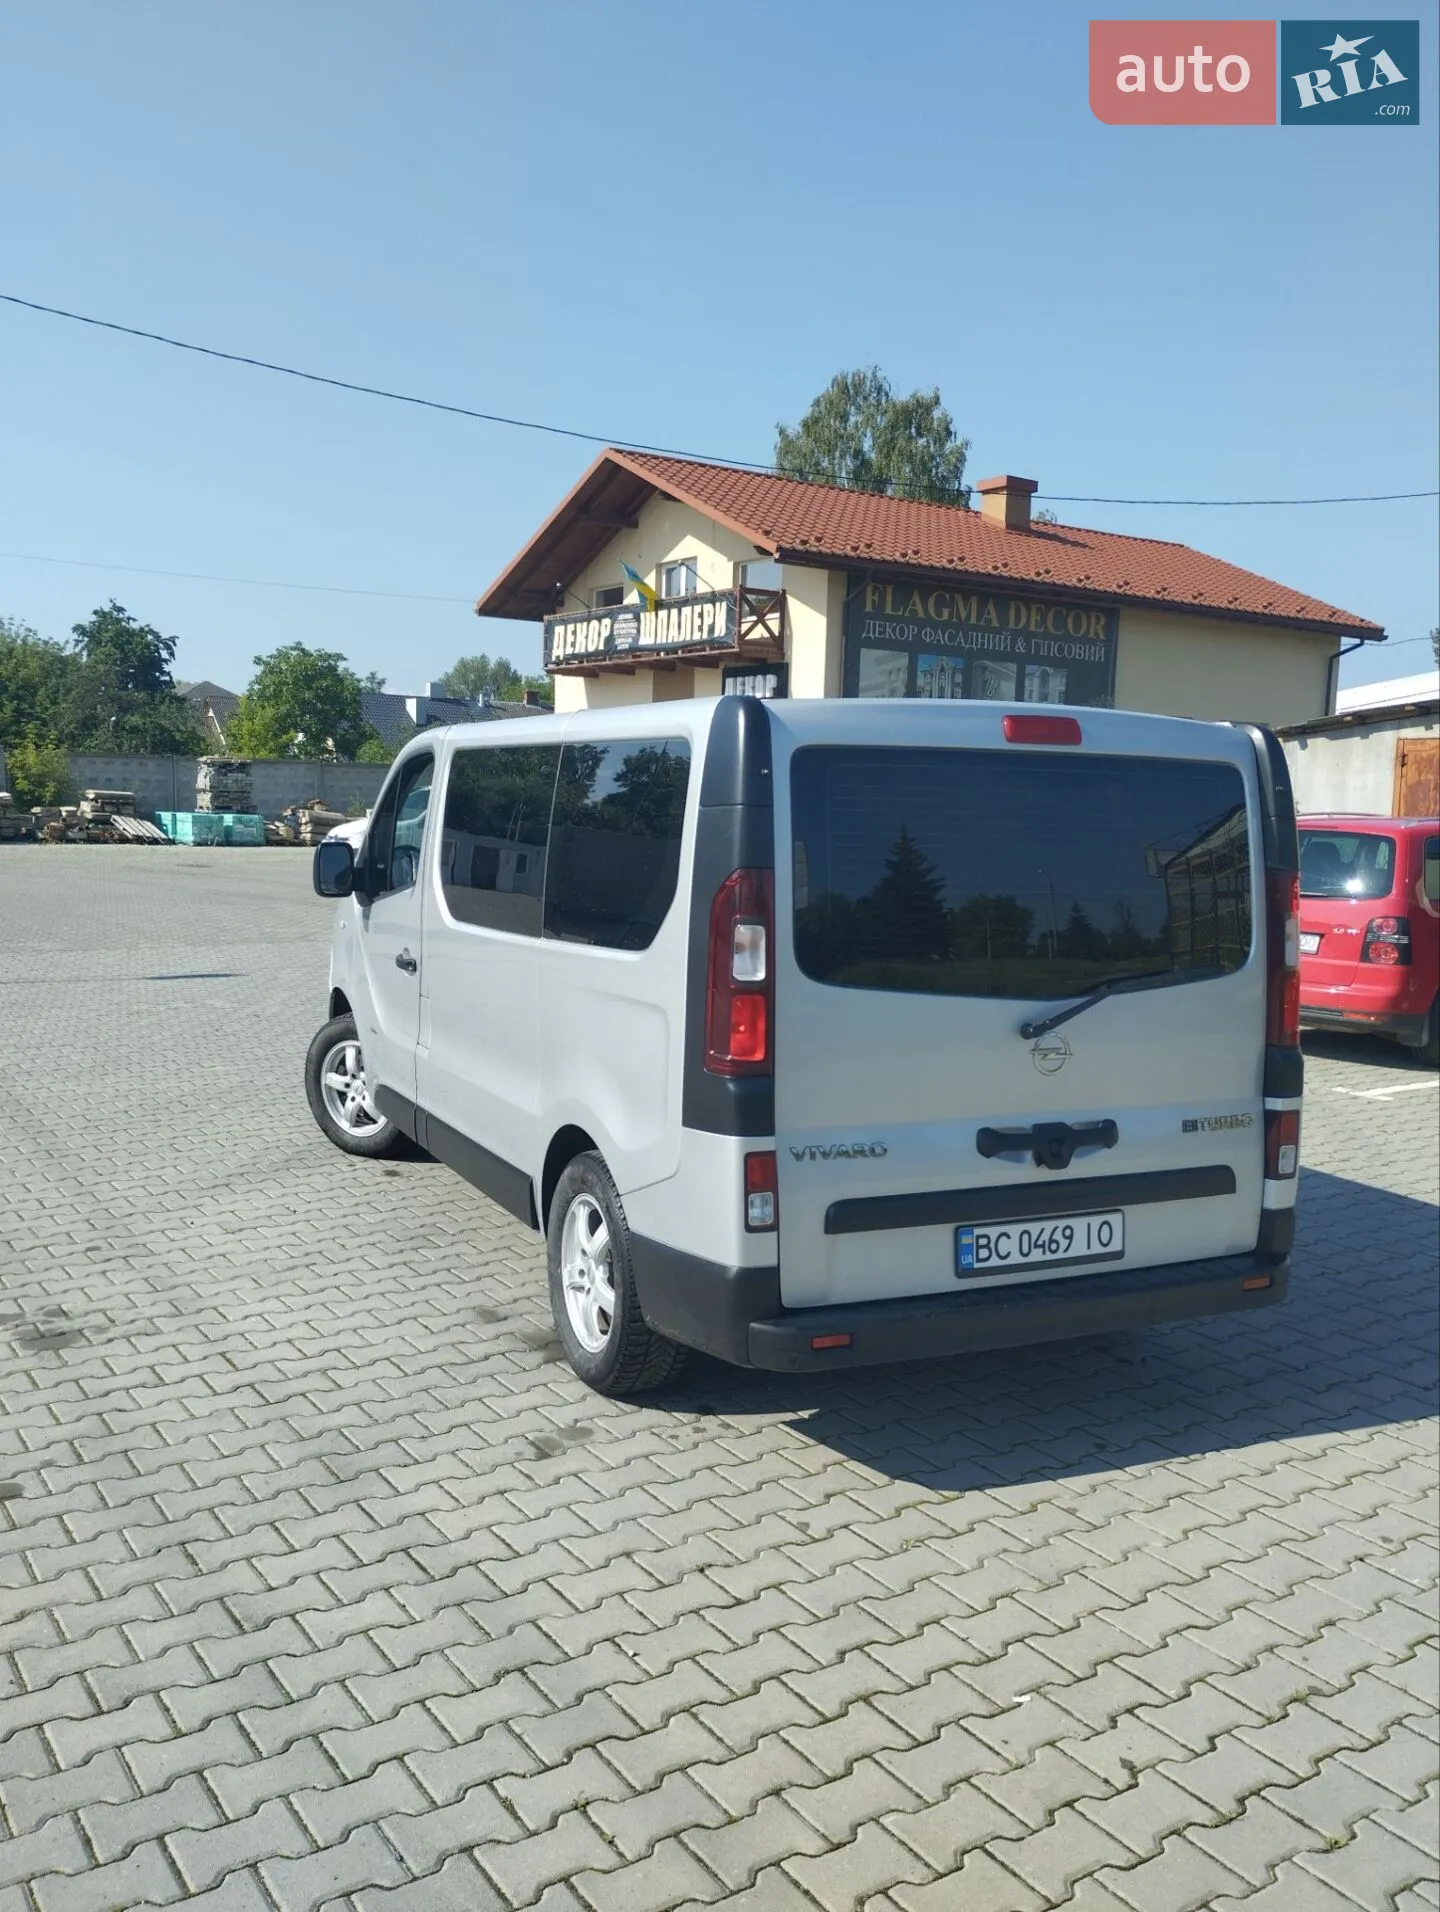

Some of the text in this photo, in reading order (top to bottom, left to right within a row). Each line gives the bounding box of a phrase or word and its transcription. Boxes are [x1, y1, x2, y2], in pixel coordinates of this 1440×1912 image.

[638, 600, 727, 645] ШПАЛЕРИ
[864, 581, 1108, 640] FLAGMA DECOR
[551, 618, 612, 661] ДЕКОР
[861, 619, 1106, 662] ДЕКОР ФАСАДНИЙ & ГІПСОВИЙ
[788, 1142, 888, 1162] VIVARO
[961, 1254, 973, 1264] UA
[975, 1231, 1012, 1263] BC
[1018, 1224, 1074, 1258] 0469
